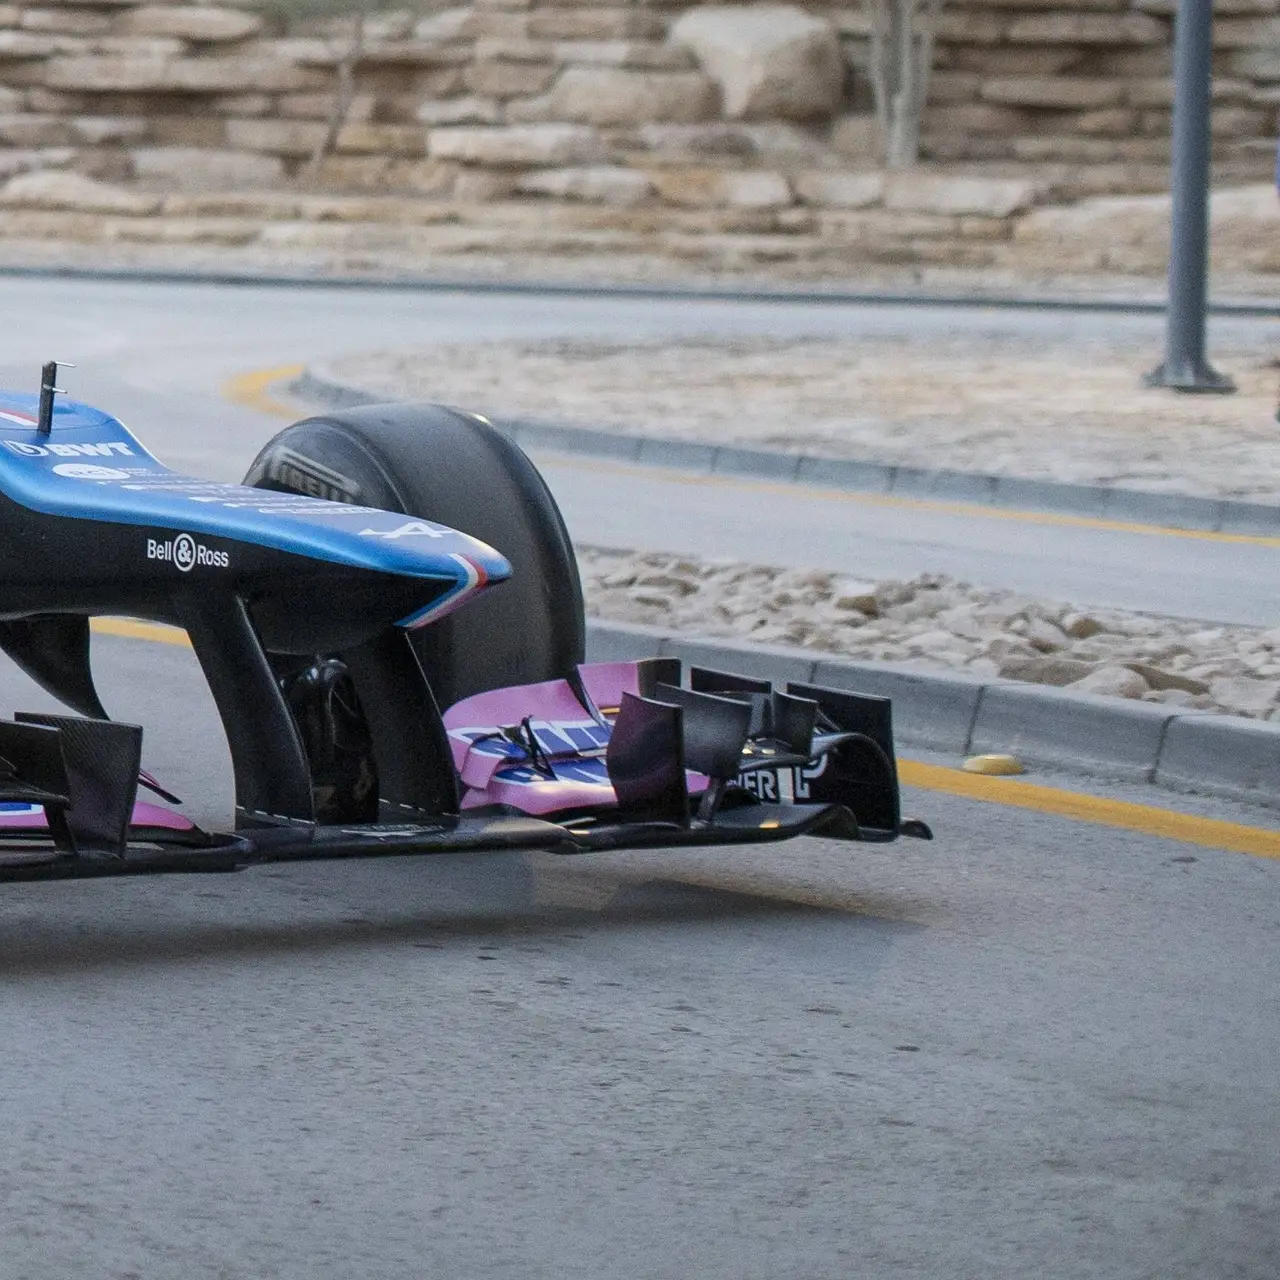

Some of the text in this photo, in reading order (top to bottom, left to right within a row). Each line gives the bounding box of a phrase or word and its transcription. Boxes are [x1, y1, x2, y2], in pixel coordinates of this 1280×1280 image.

[43, 442, 136, 456] BWT
[147, 538, 172, 561] Bell
[197, 544, 229, 568] Ross
